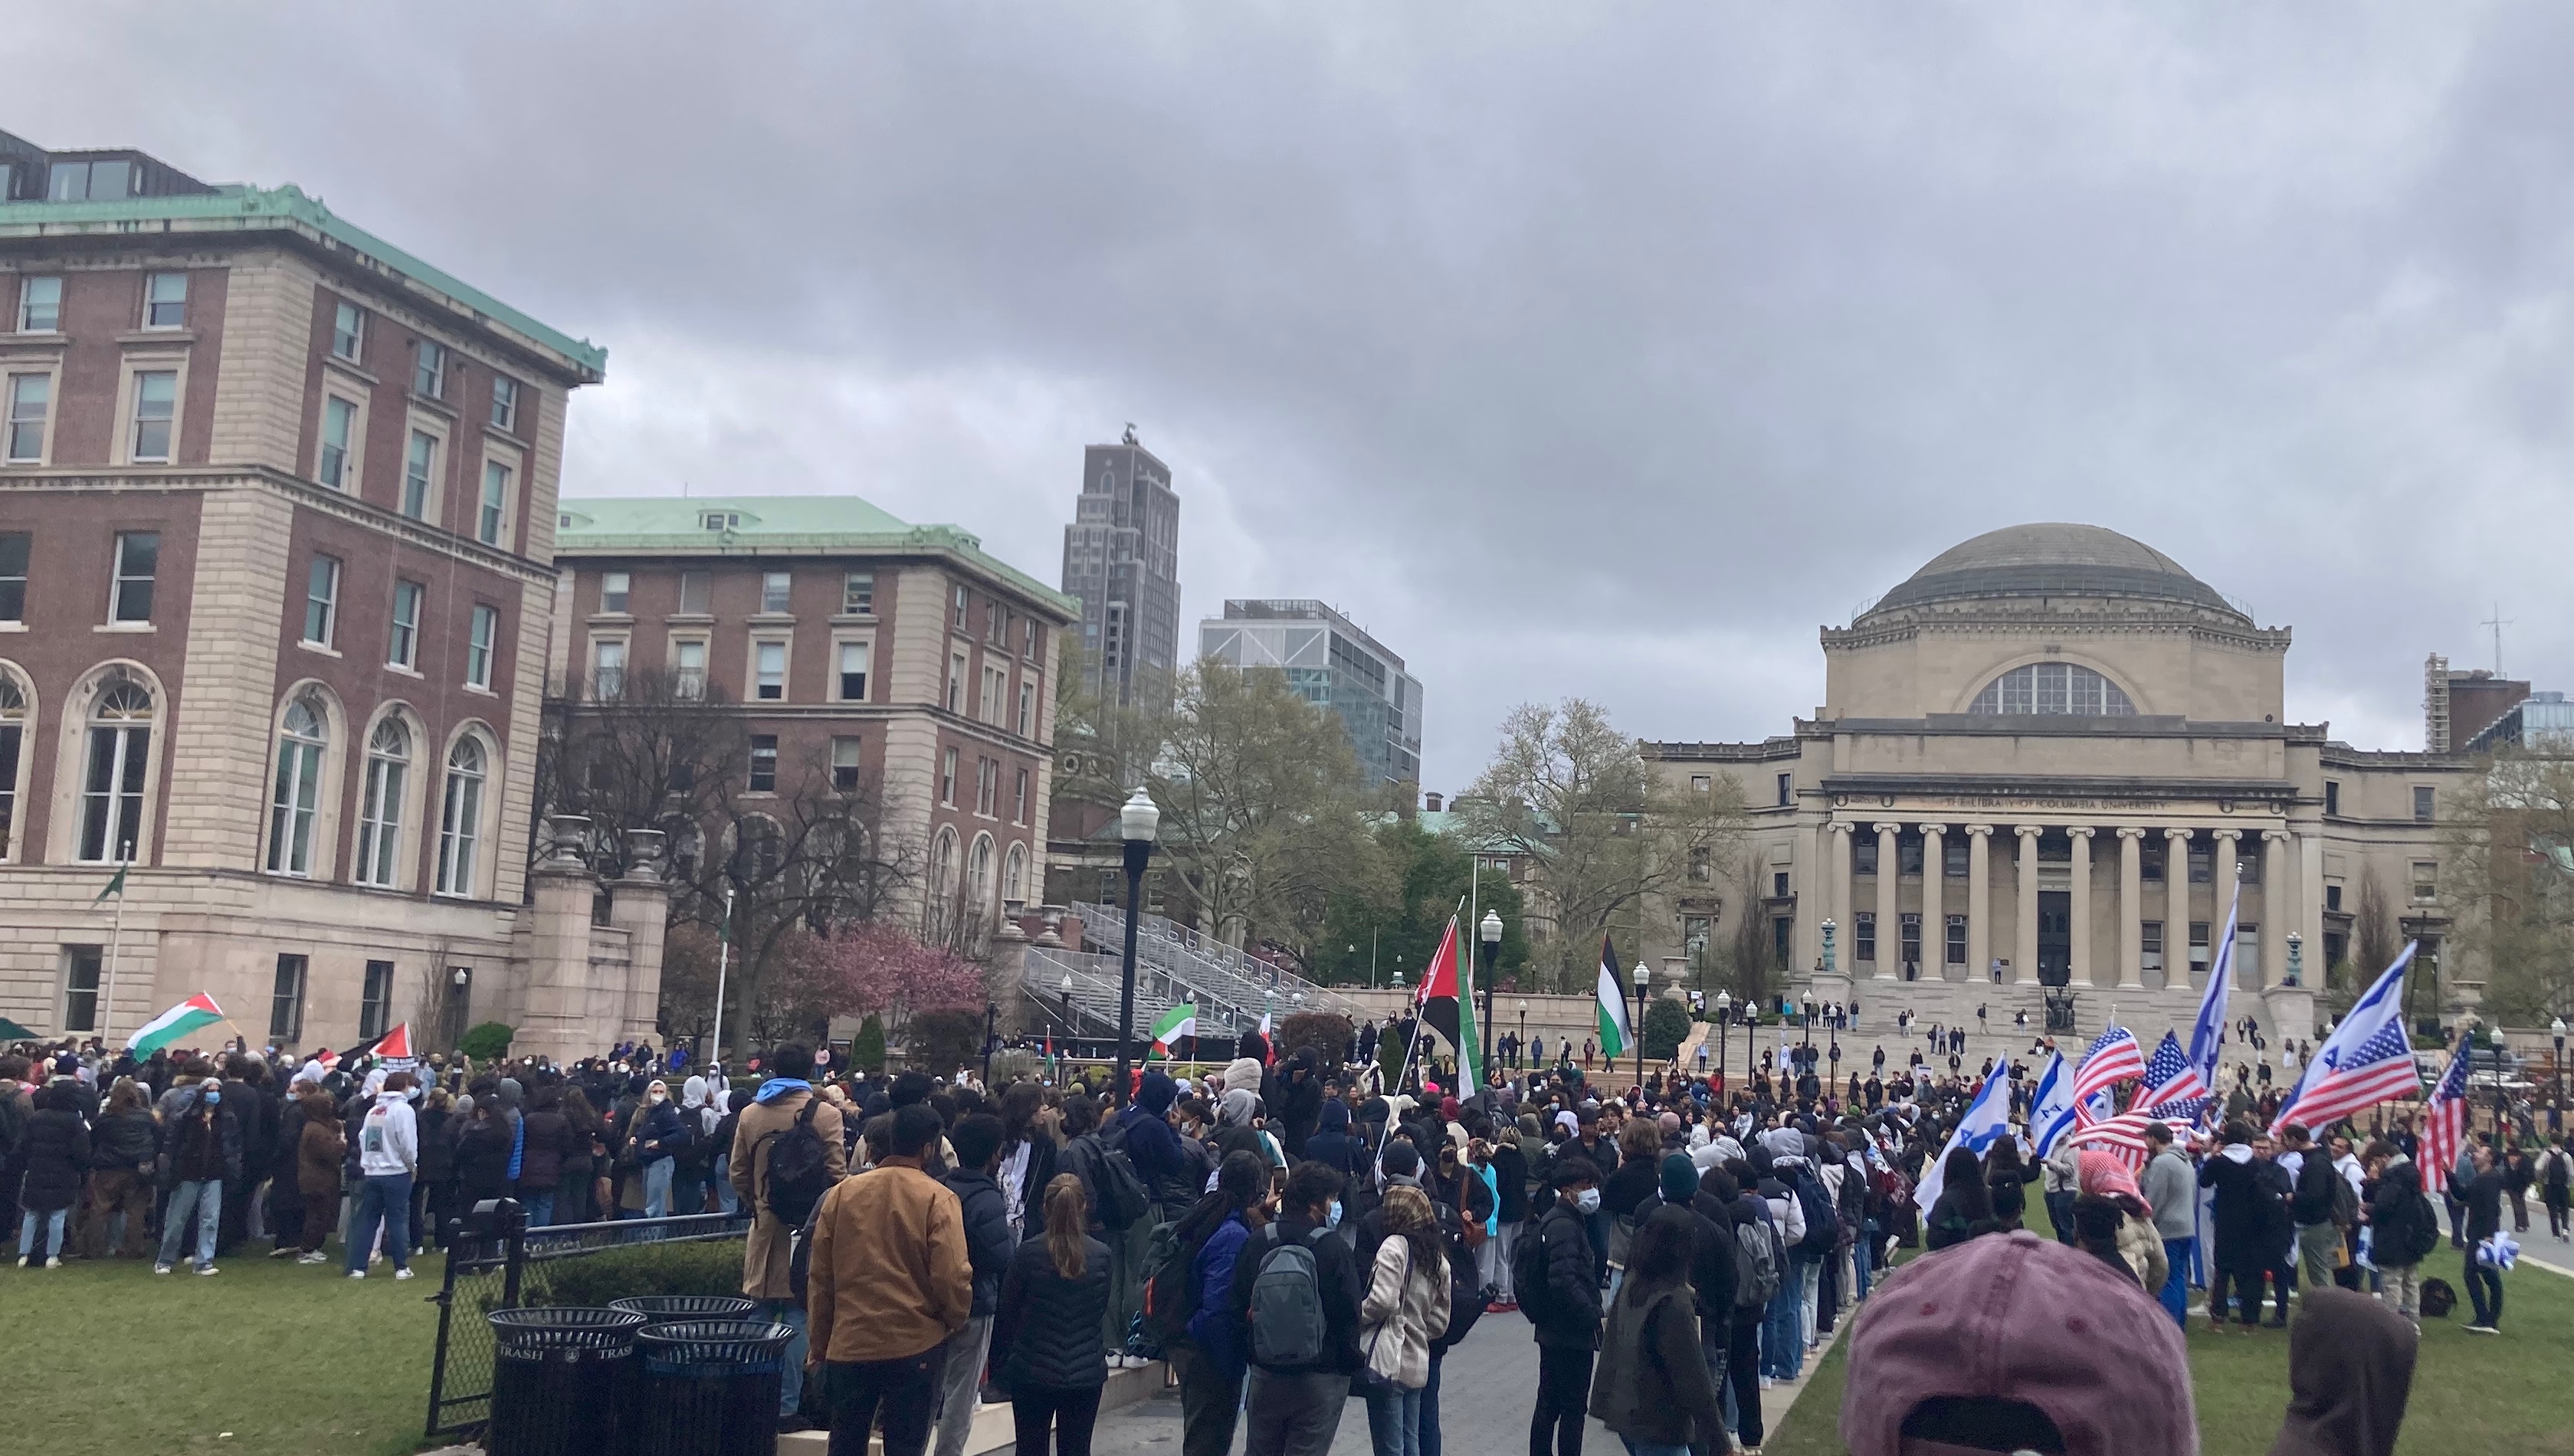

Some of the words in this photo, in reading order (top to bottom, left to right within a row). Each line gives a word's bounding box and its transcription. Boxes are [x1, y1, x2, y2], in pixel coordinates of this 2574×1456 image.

[2020, 799, 2036, 808] OF
[2040, 799, 2097, 809] COLUMBIA
[500, 1345, 543, 1361] TRASH
[598, 1345, 633, 1359] TRAS
